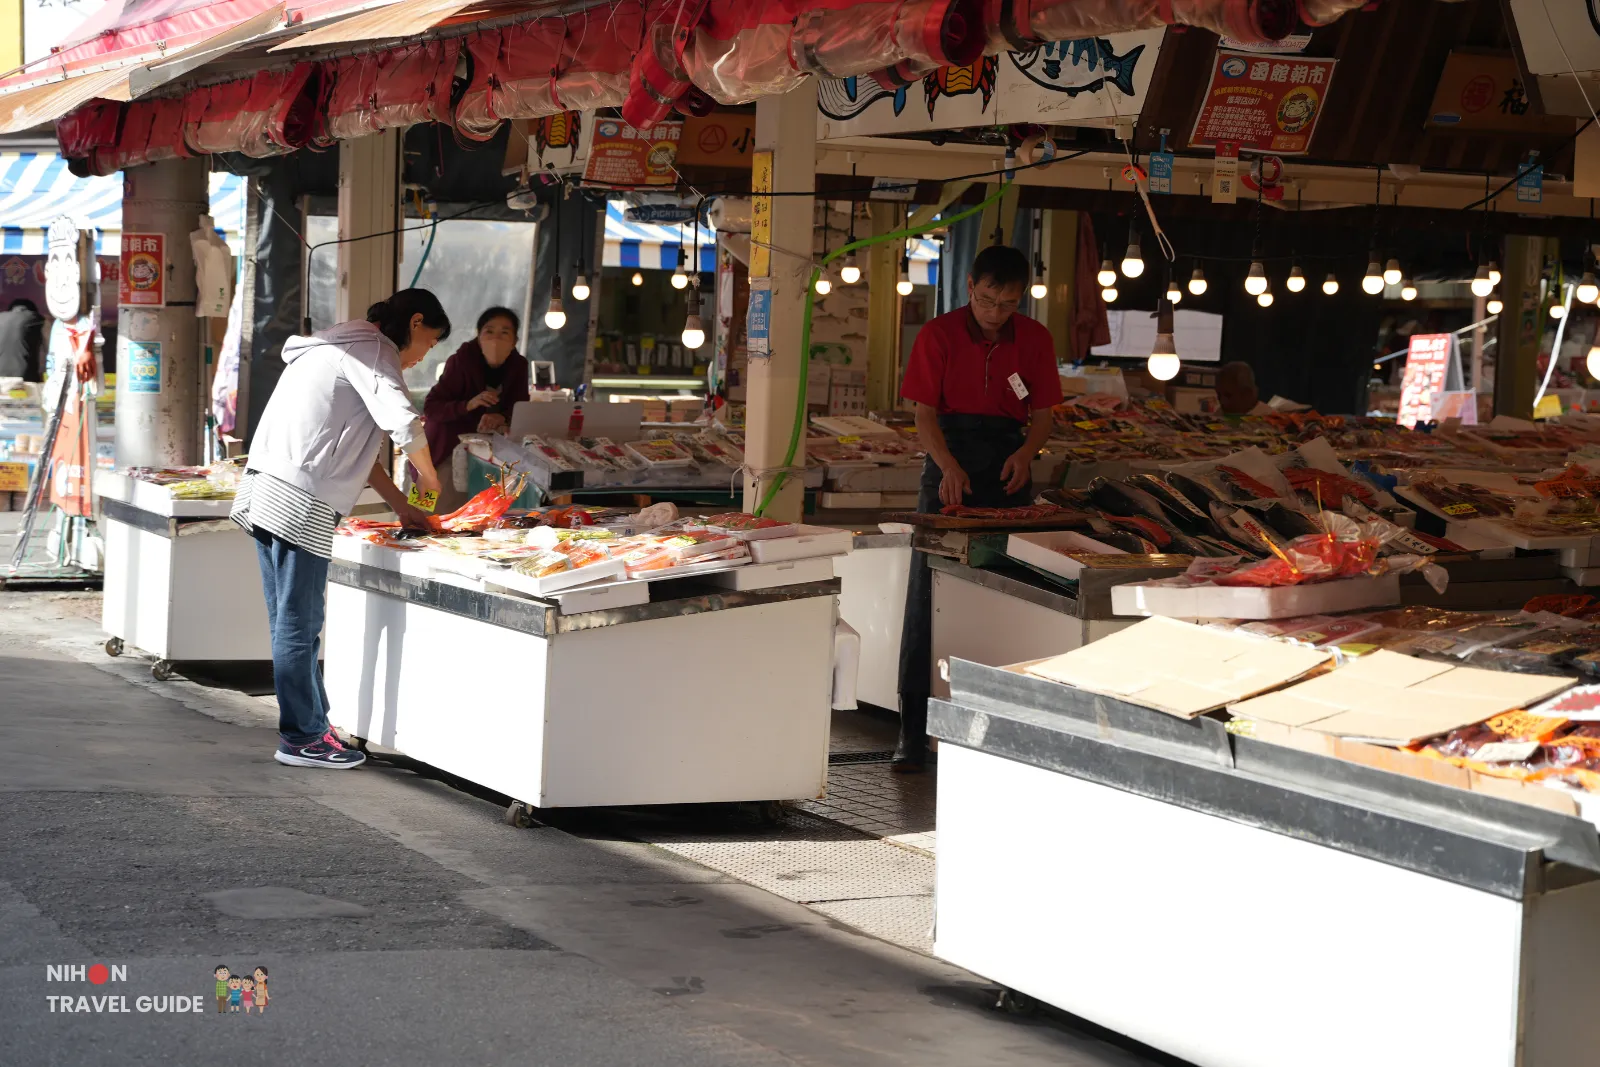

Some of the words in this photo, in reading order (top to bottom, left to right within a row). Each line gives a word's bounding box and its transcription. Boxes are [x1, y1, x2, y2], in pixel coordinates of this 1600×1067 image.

[1250, 61, 1325, 84] 函館朝市
[651, 210, 691, 219] FIGHTERS
